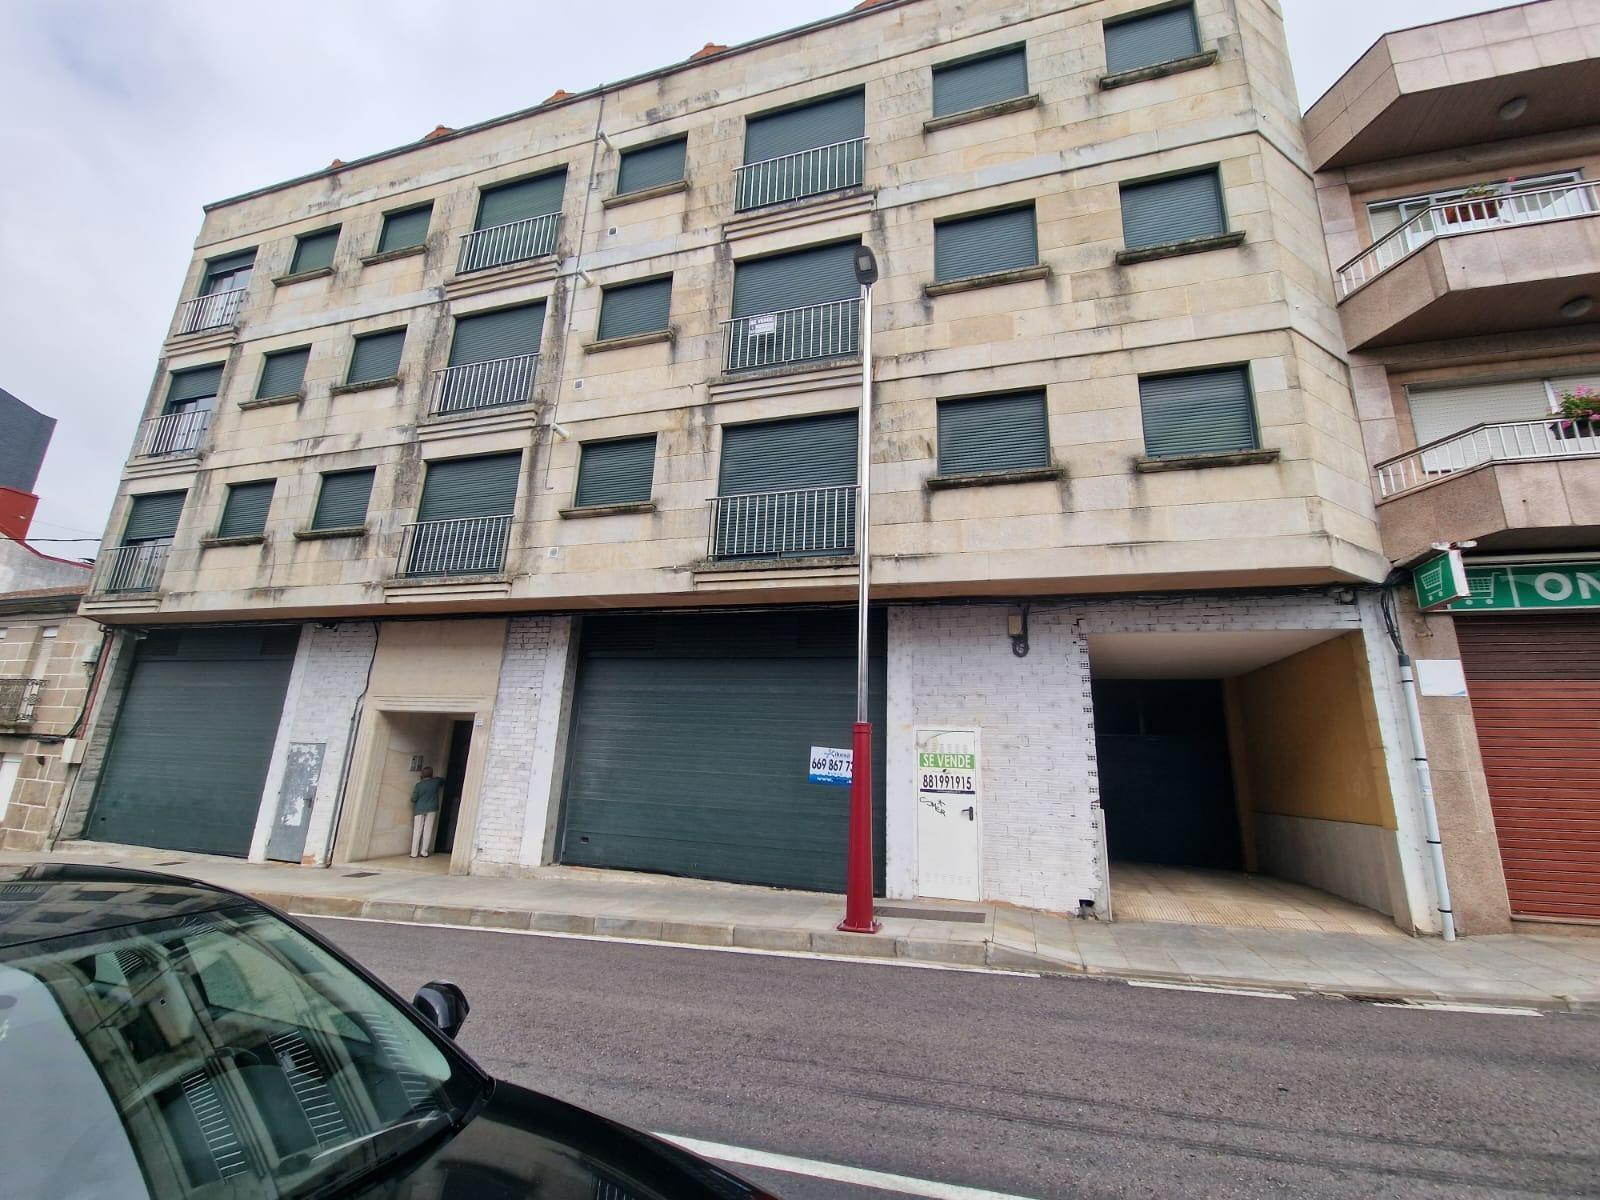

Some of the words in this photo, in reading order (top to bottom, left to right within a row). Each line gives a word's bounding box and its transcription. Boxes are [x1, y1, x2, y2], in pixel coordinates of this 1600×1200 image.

[811, 758, 827, 770] 669
[828, 759, 844, 772] 867
[923, 754, 934, 767] SE
[937, 754, 971, 769] VENDE
[922, 774, 972, 790] 881991915
